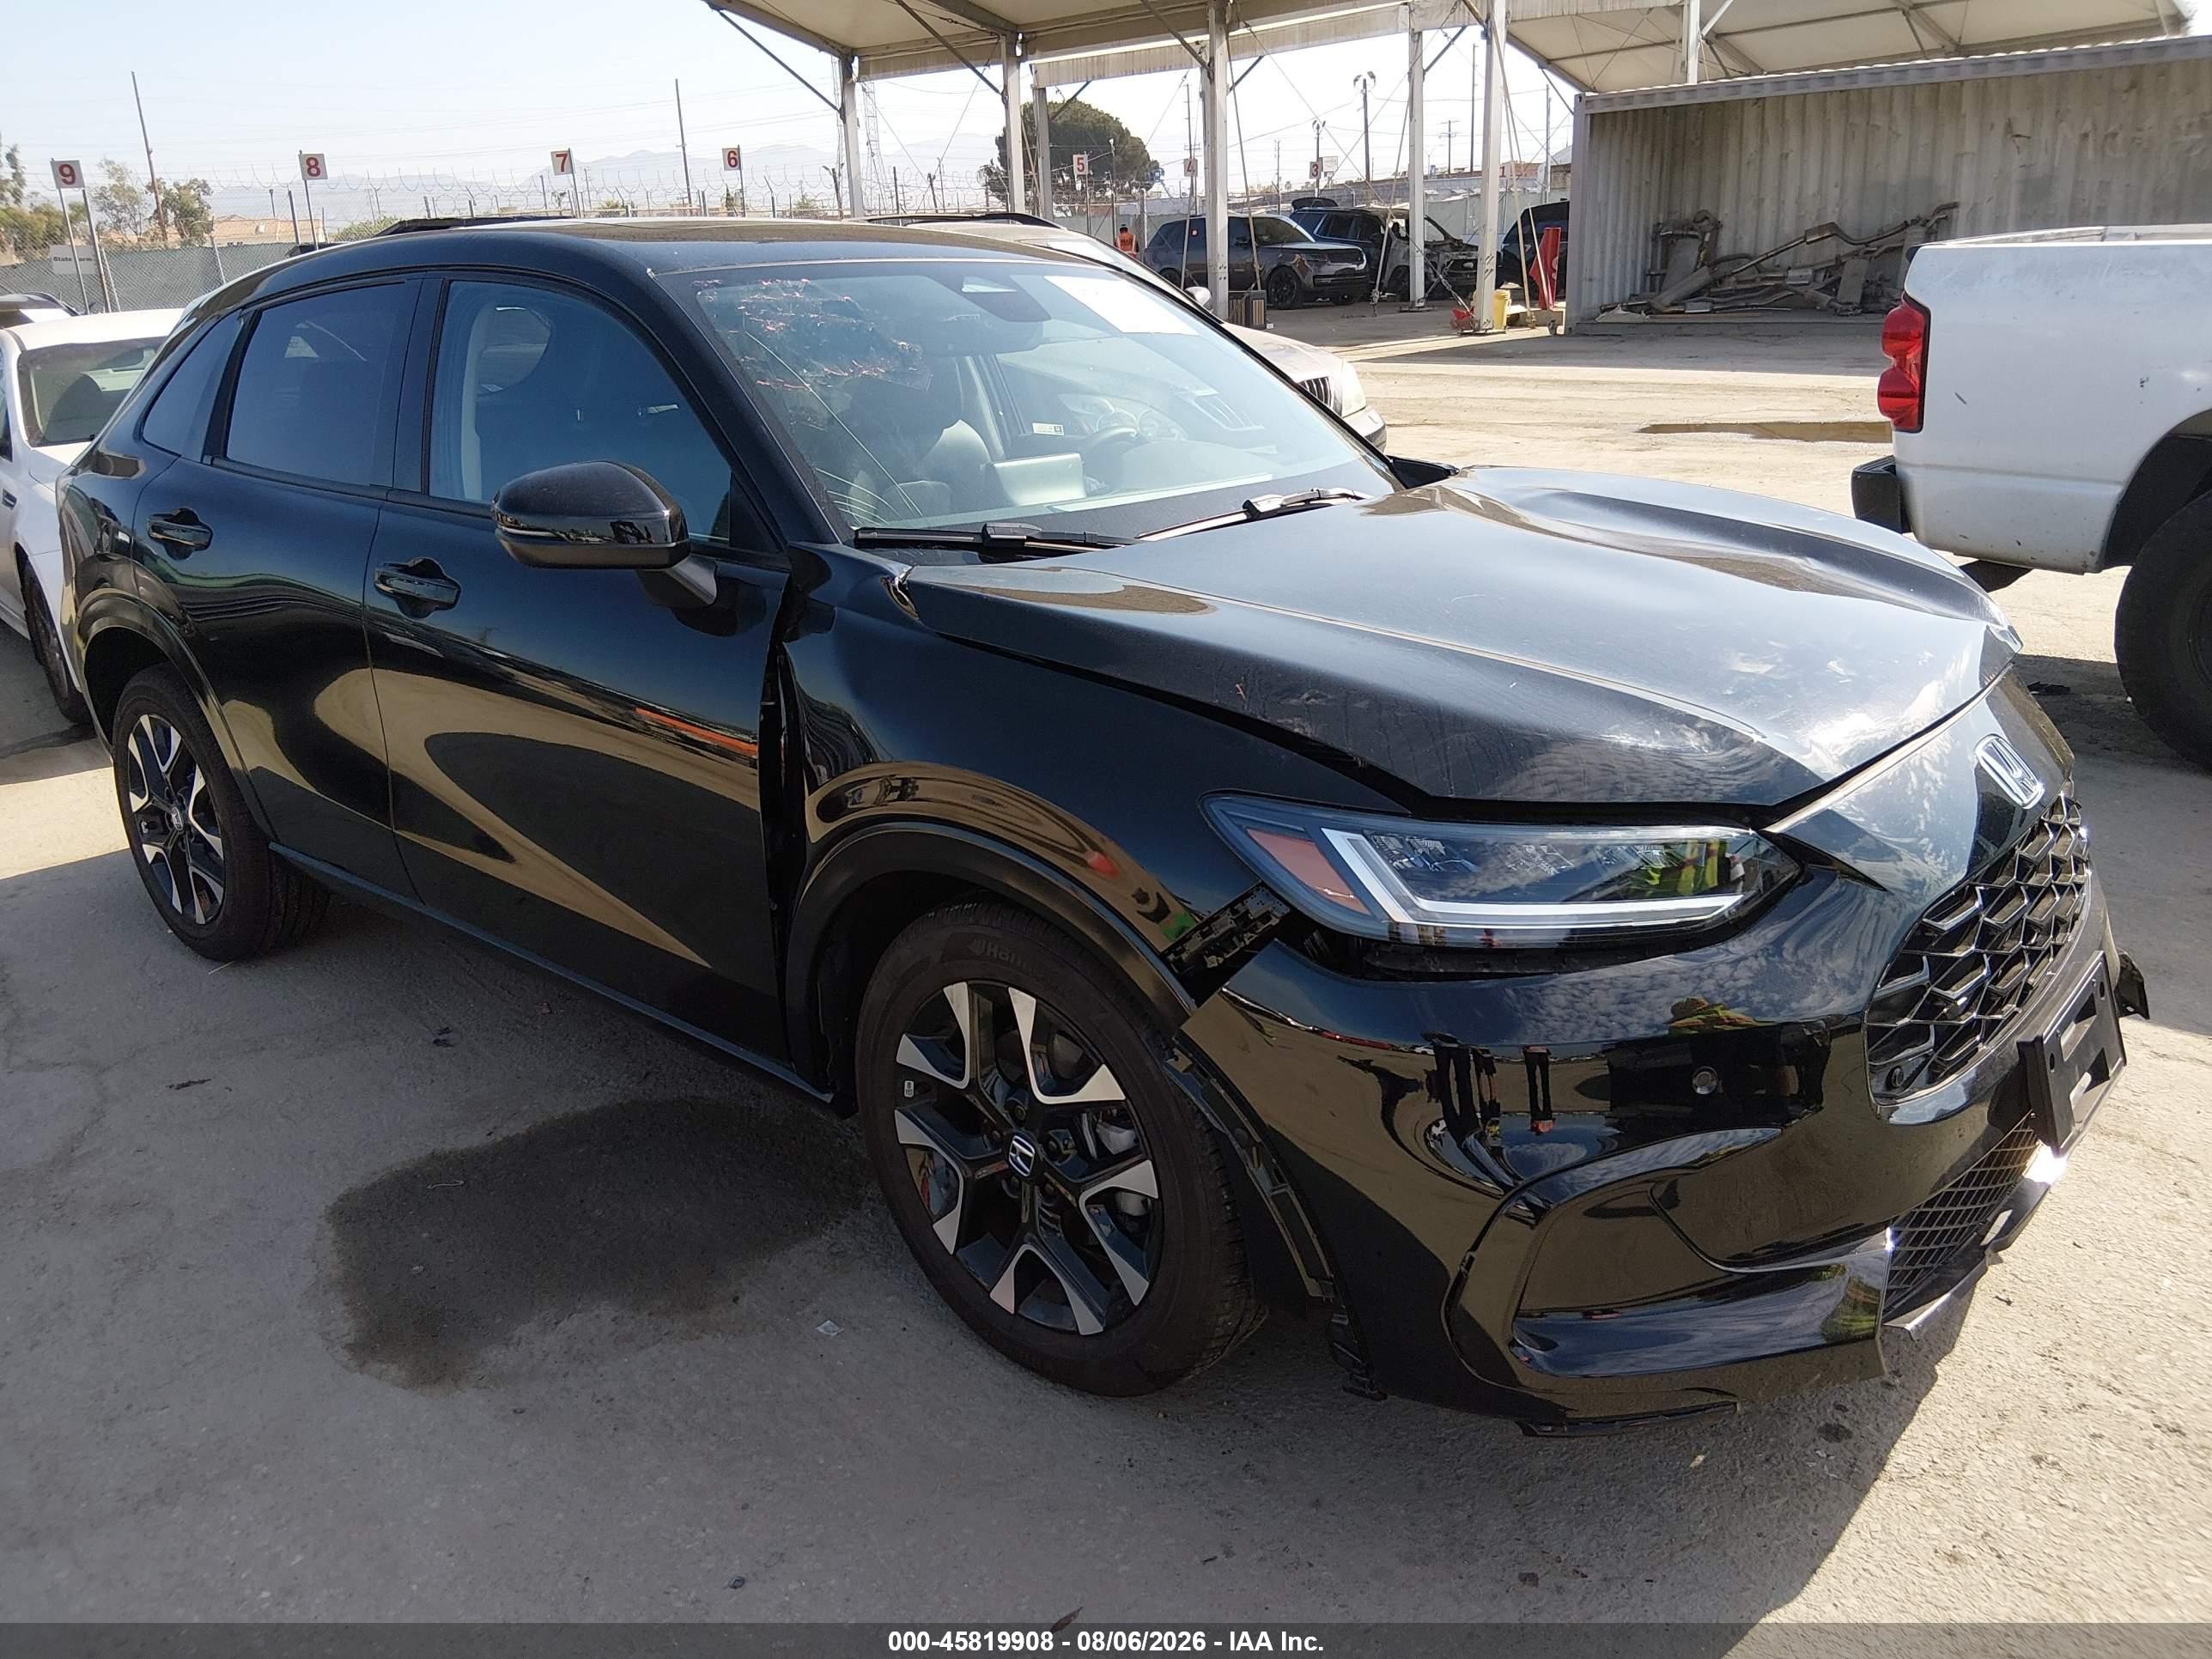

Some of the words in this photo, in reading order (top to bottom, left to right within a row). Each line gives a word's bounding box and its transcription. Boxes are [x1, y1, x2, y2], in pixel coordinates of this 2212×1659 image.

[307, 157, 320, 177] 8
[556, 154, 568, 172] 7
[727, 150, 738, 167] 6
[1077, 157, 1085, 172] 5
[58, 164, 76, 185] 9
[1312, 164, 1319, 177] 3
